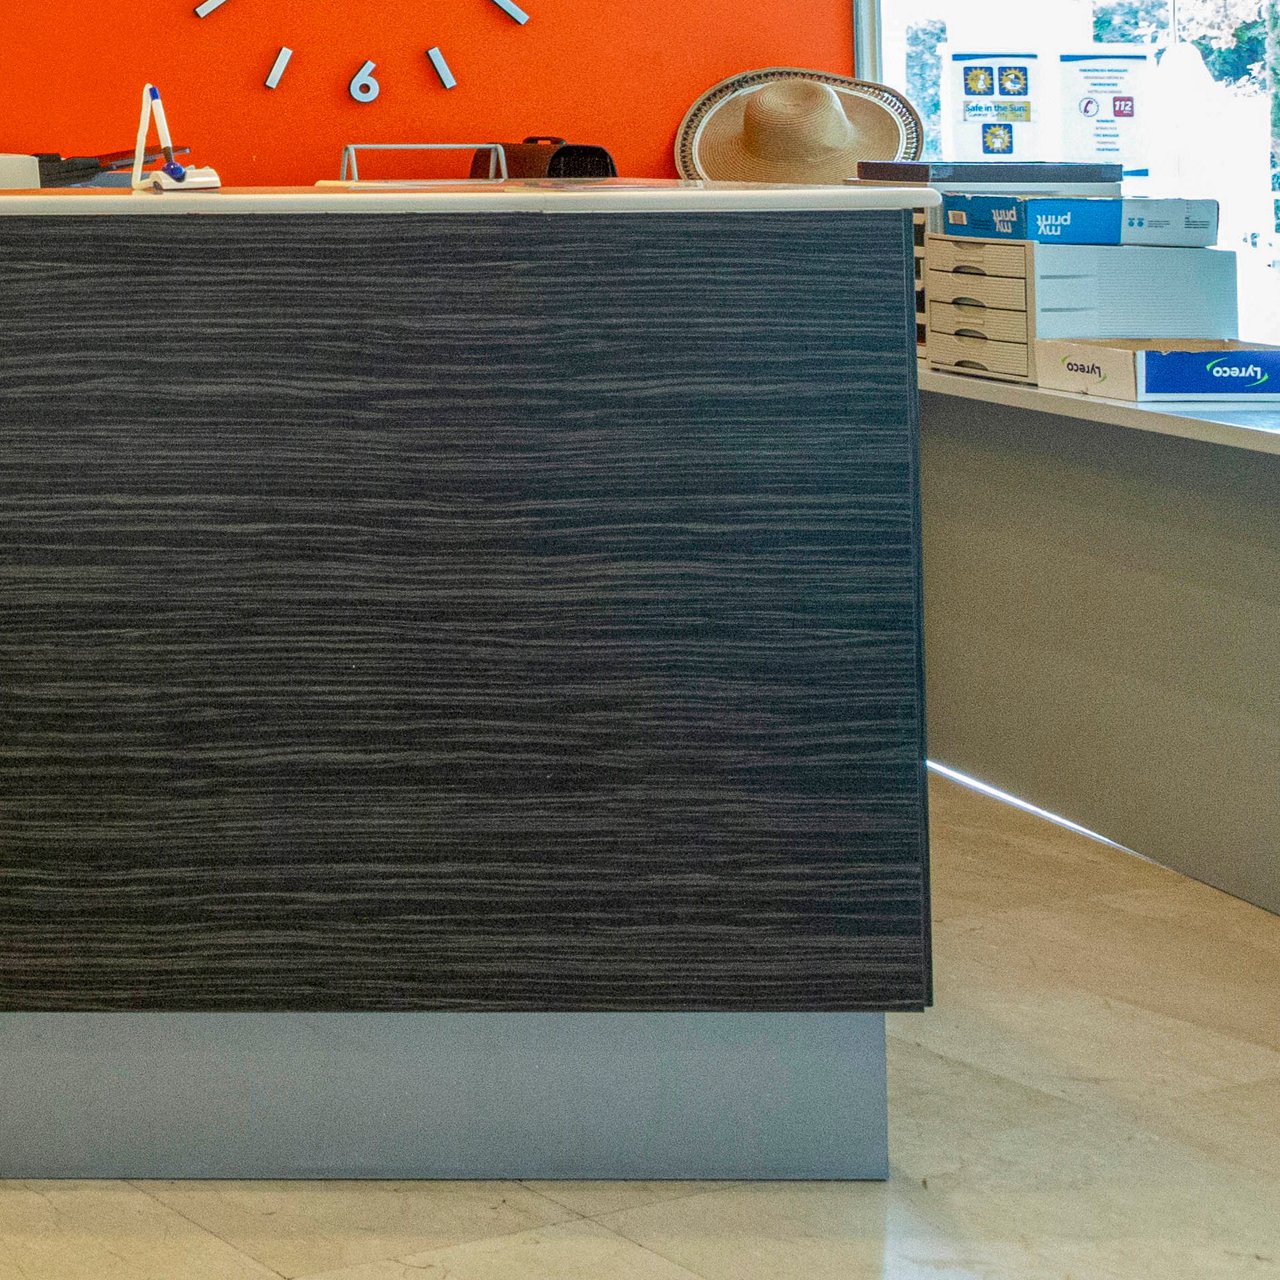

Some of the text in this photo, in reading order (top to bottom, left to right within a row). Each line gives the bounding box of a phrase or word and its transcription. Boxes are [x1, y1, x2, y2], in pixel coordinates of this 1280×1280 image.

[349, 60, 380, 103] 6
[966, 102, 983, 112] Safe
[984, 102, 992, 112] in
[993, 103, 1008, 112] the
[1114, 101, 1133, 111] 112
[991, 206, 1018, 224] print
[1036, 211, 1072, 226] print
[995, 219, 1013, 233] my
[1037, 222, 1061, 236] my
[1066, 361, 1102, 378] Lyreco
[1212, 364, 1262, 380] Lyreco
